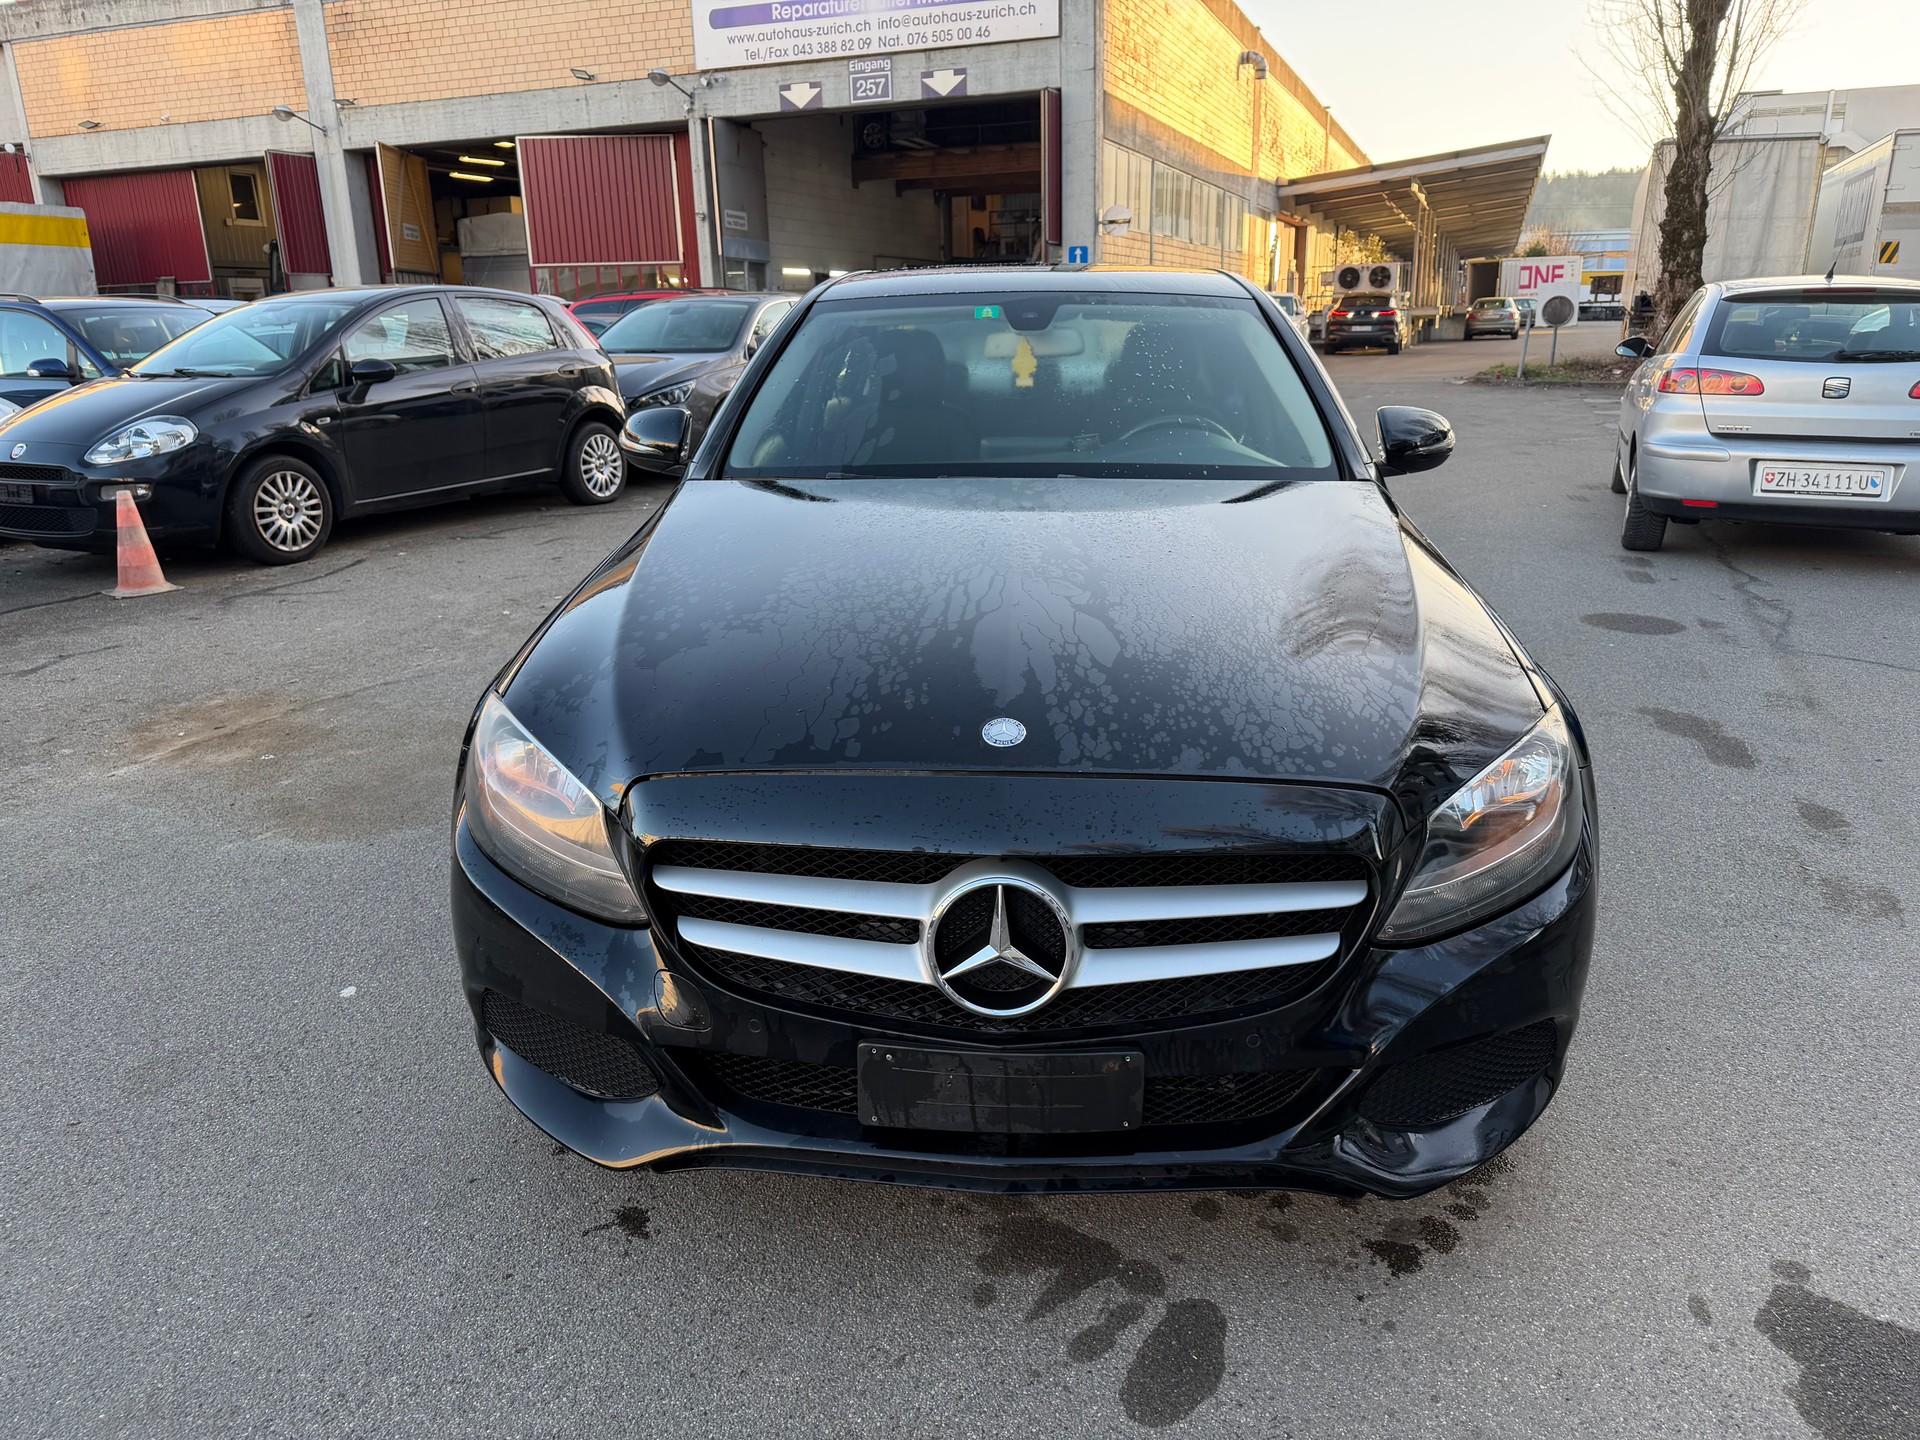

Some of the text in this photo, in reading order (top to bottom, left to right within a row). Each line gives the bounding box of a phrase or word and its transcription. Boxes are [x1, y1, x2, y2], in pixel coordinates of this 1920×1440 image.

[727, 3, 1036, 44] www.autohaus-zurich.ch info@autohaus-zurich.ch
[744, 25, 991, 61] Tel./Fax 043 388 82 09 Nat. 076 505 00 46
[849, 60, 890, 72] Eingang
[856, 78, 886, 97] 257
[1775, 472, 1870, 490] ZH 34111 U
